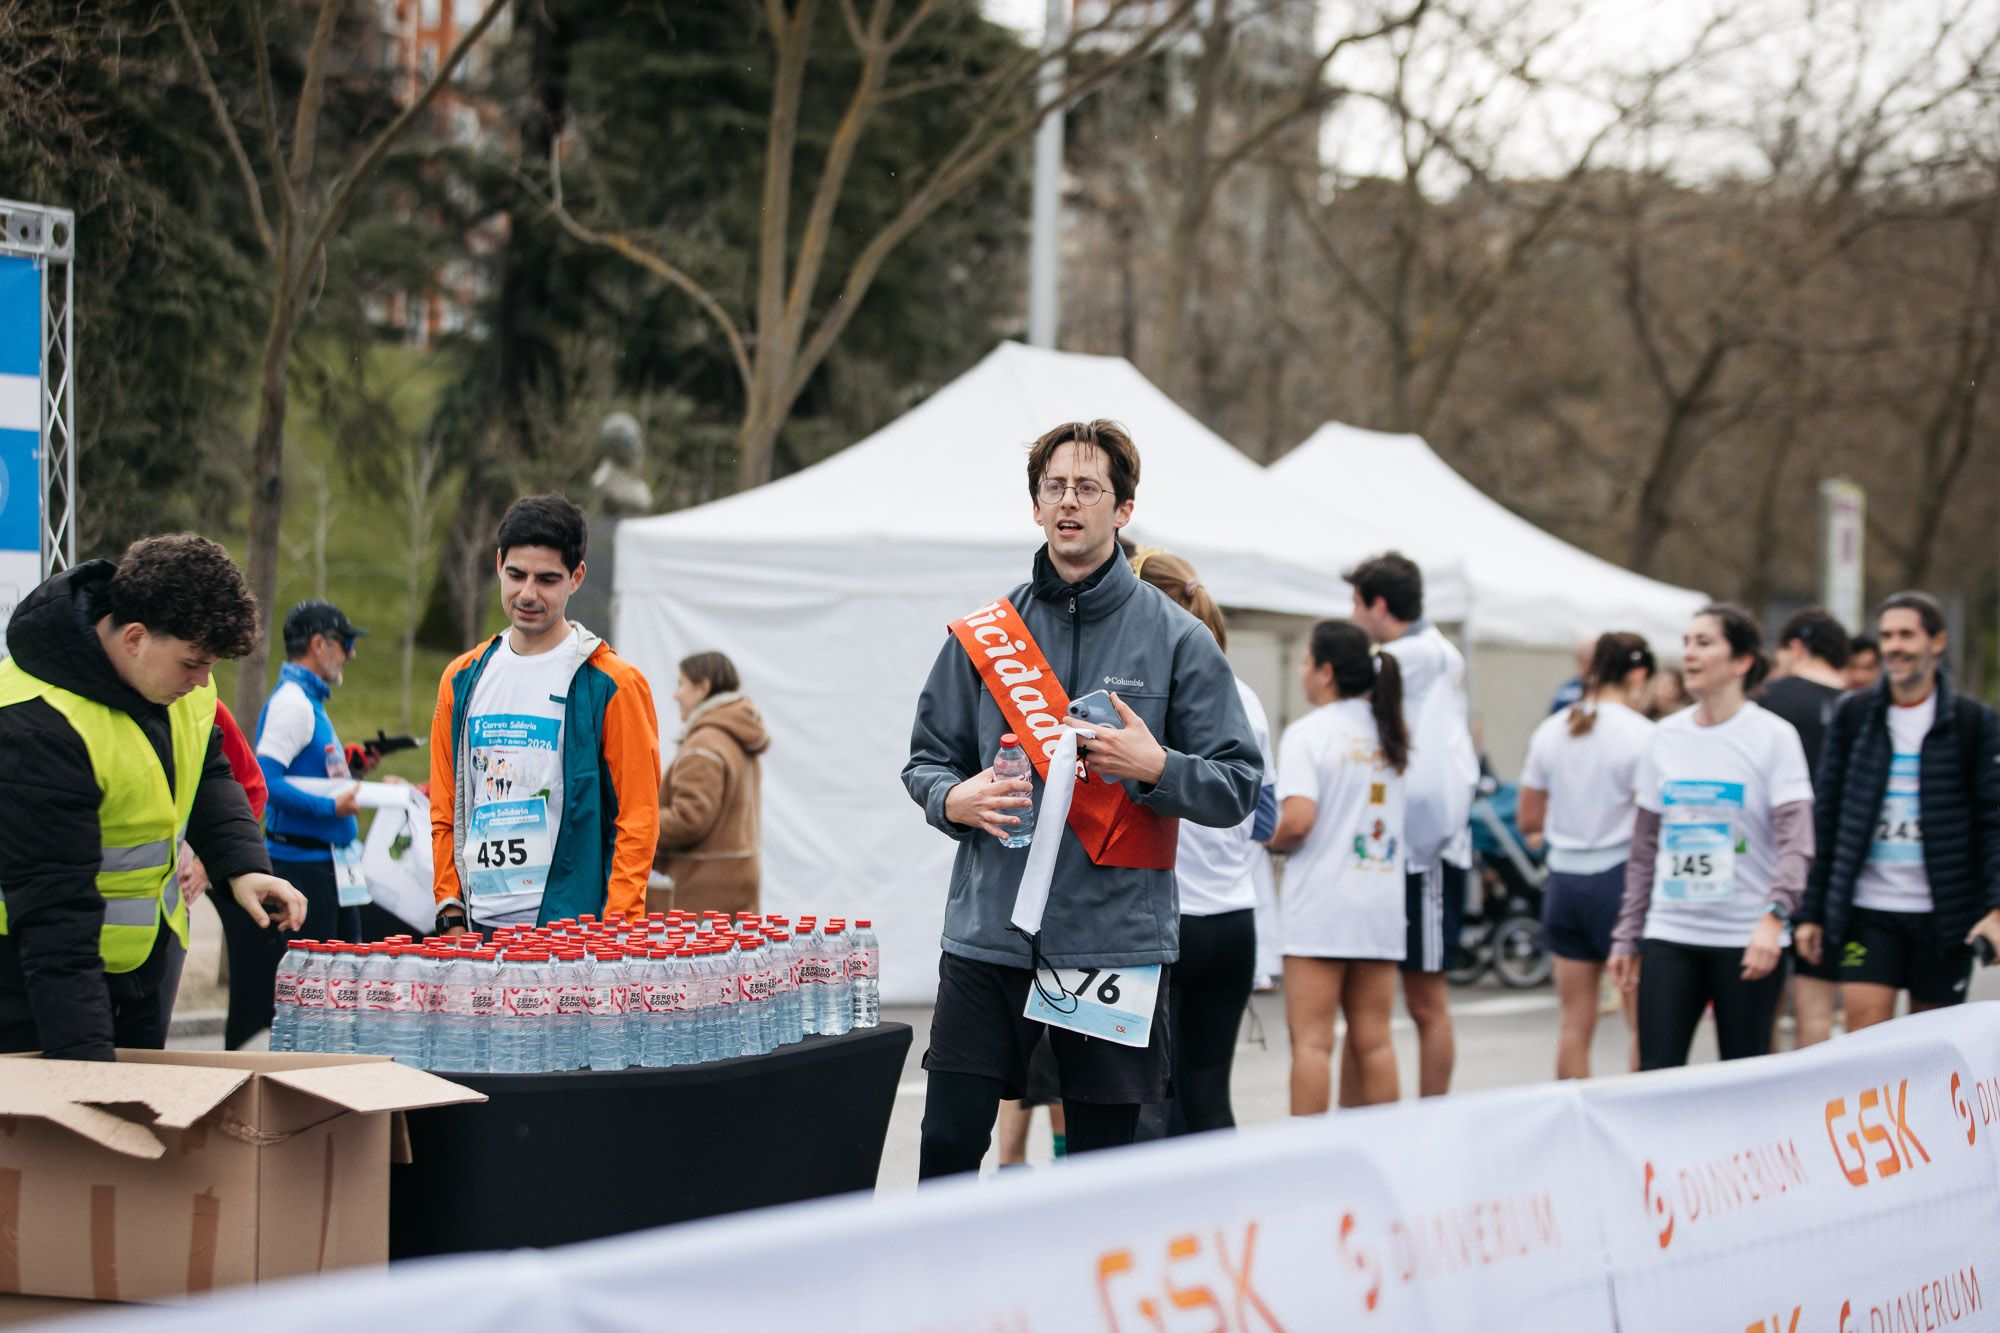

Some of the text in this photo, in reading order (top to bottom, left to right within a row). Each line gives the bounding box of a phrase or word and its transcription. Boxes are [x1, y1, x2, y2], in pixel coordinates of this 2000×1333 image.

[1111, 676, 1144, 687] Columbia
[510, 720, 537, 731] Solidaria
[527, 738, 553, 751] 2026
[496, 807, 529, 817] Solidaria
[477, 838, 528, 868] 435
[1672, 854, 1713, 876] 145
[366, 989, 390, 997] ZERO
[1074, 968, 1121, 1005] 76
[1115, 1025, 1127, 1034] CSL
[1824, 1078, 1932, 1187] GSK
[1679, 1137, 1810, 1222] DIAVERUM
[1095, 1220, 1290, 1333] GSK
[1870, 1264, 1983, 1333] DIAVERUM
